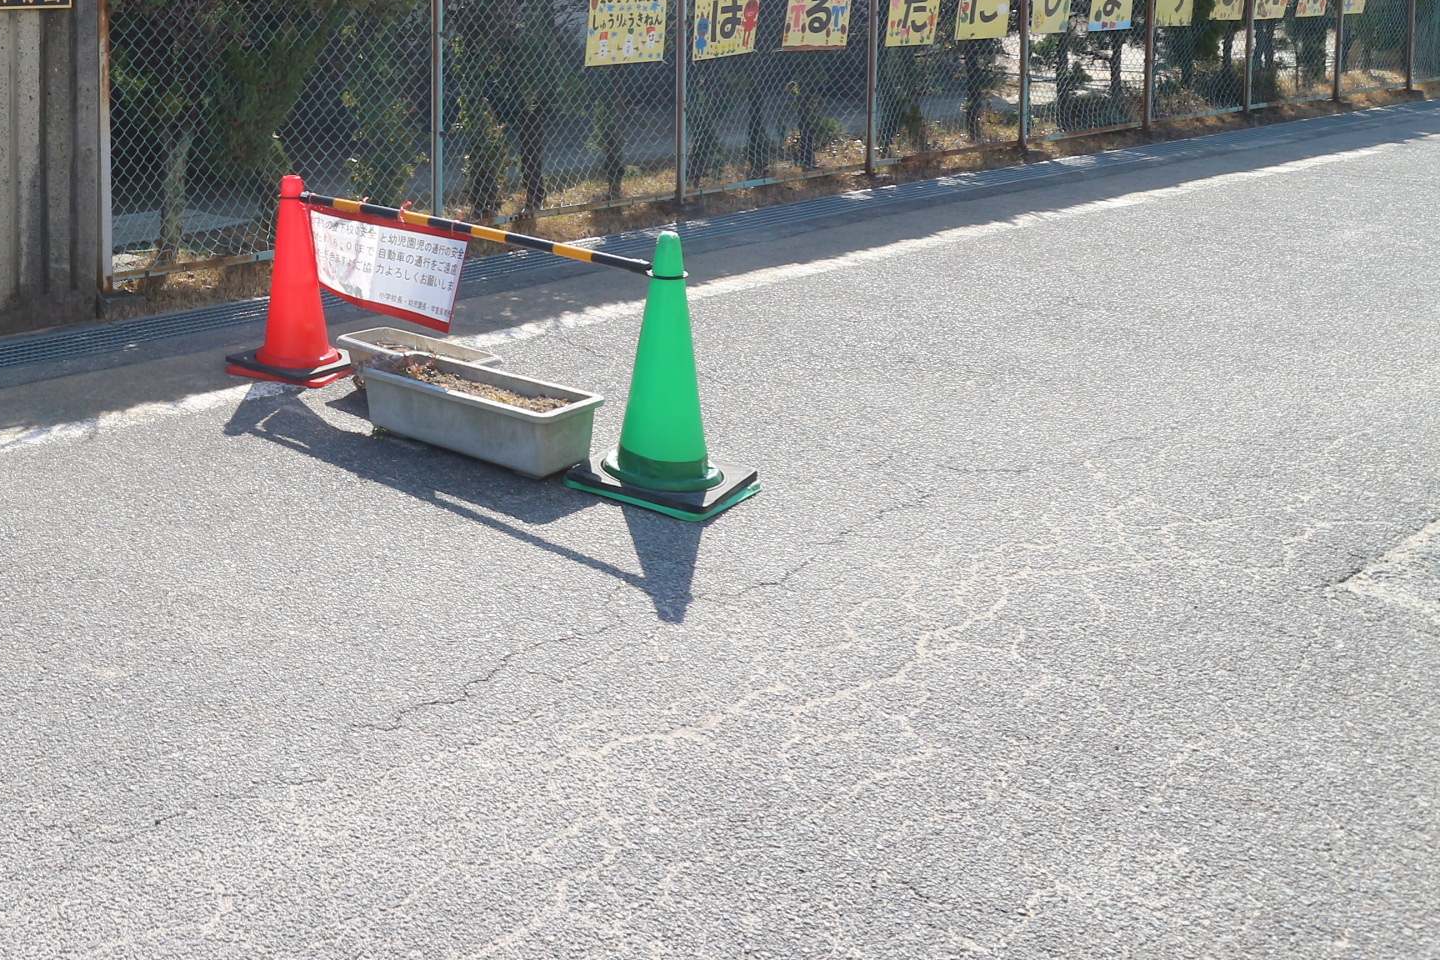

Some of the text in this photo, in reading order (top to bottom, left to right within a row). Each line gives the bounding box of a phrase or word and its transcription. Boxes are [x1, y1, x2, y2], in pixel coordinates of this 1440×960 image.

[592, 13, 663, 30] しゅうりょうきねん
